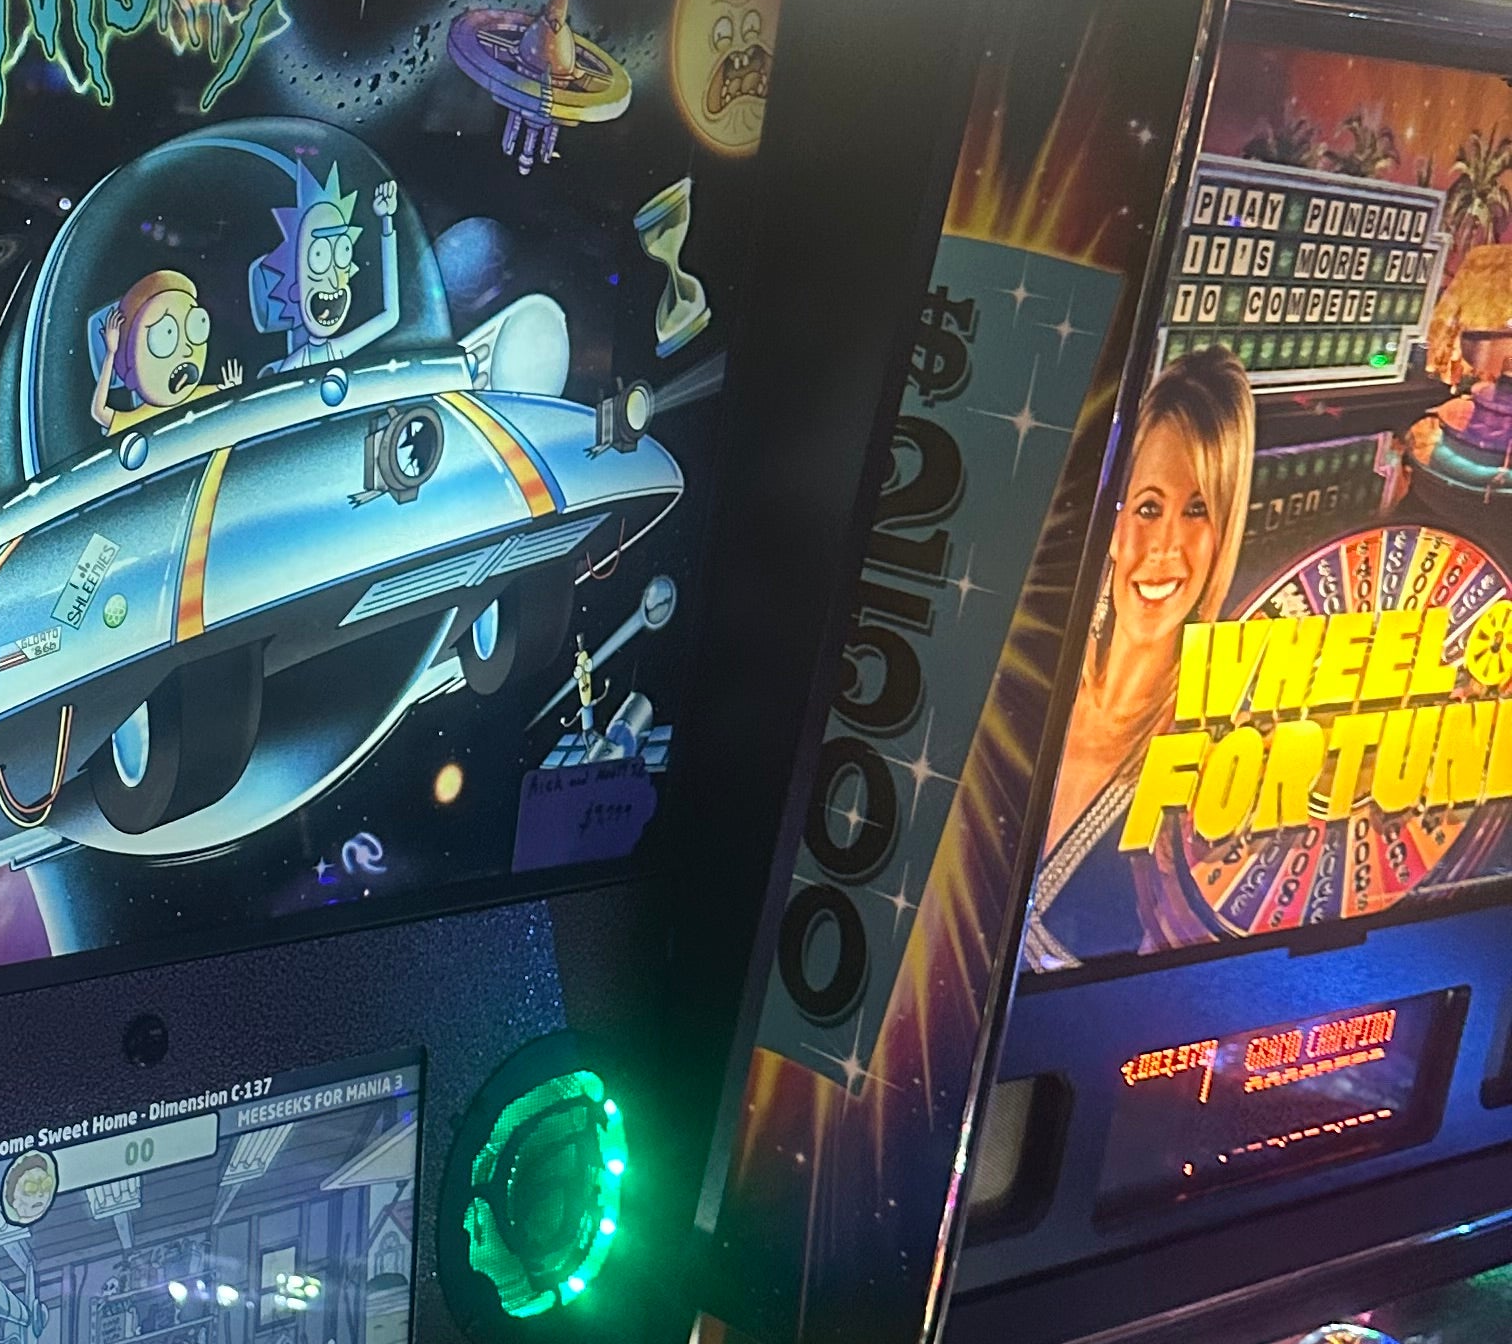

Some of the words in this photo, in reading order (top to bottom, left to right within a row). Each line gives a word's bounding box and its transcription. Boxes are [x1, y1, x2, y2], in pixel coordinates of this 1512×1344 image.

[1197, 191, 1283, 227] PLAY
[1306, 202, 1427, 240] PINBALL
[1187, 239, 1273, 272] IT'S
[1297, 246, 1370, 278] MORE
[1387, 252, 1433, 283] FUN
[1177, 287, 1220, 320] TO
[1247, 288, 1376, 321] COMPETE
[1175, 606, 1458, 722] WHEEL
[37, 1119, 89, 1148] Sweet
[92, 1110, 138, 1134] Home
[149, 1088, 228, 1121] Dimension
[237, 1094, 312, 1128] MEESEEKS
[315, 1086, 343, 1109] FOR
[346, 1077, 392, 1103] MANIA
[393, 1074, 403, 1090] 3
